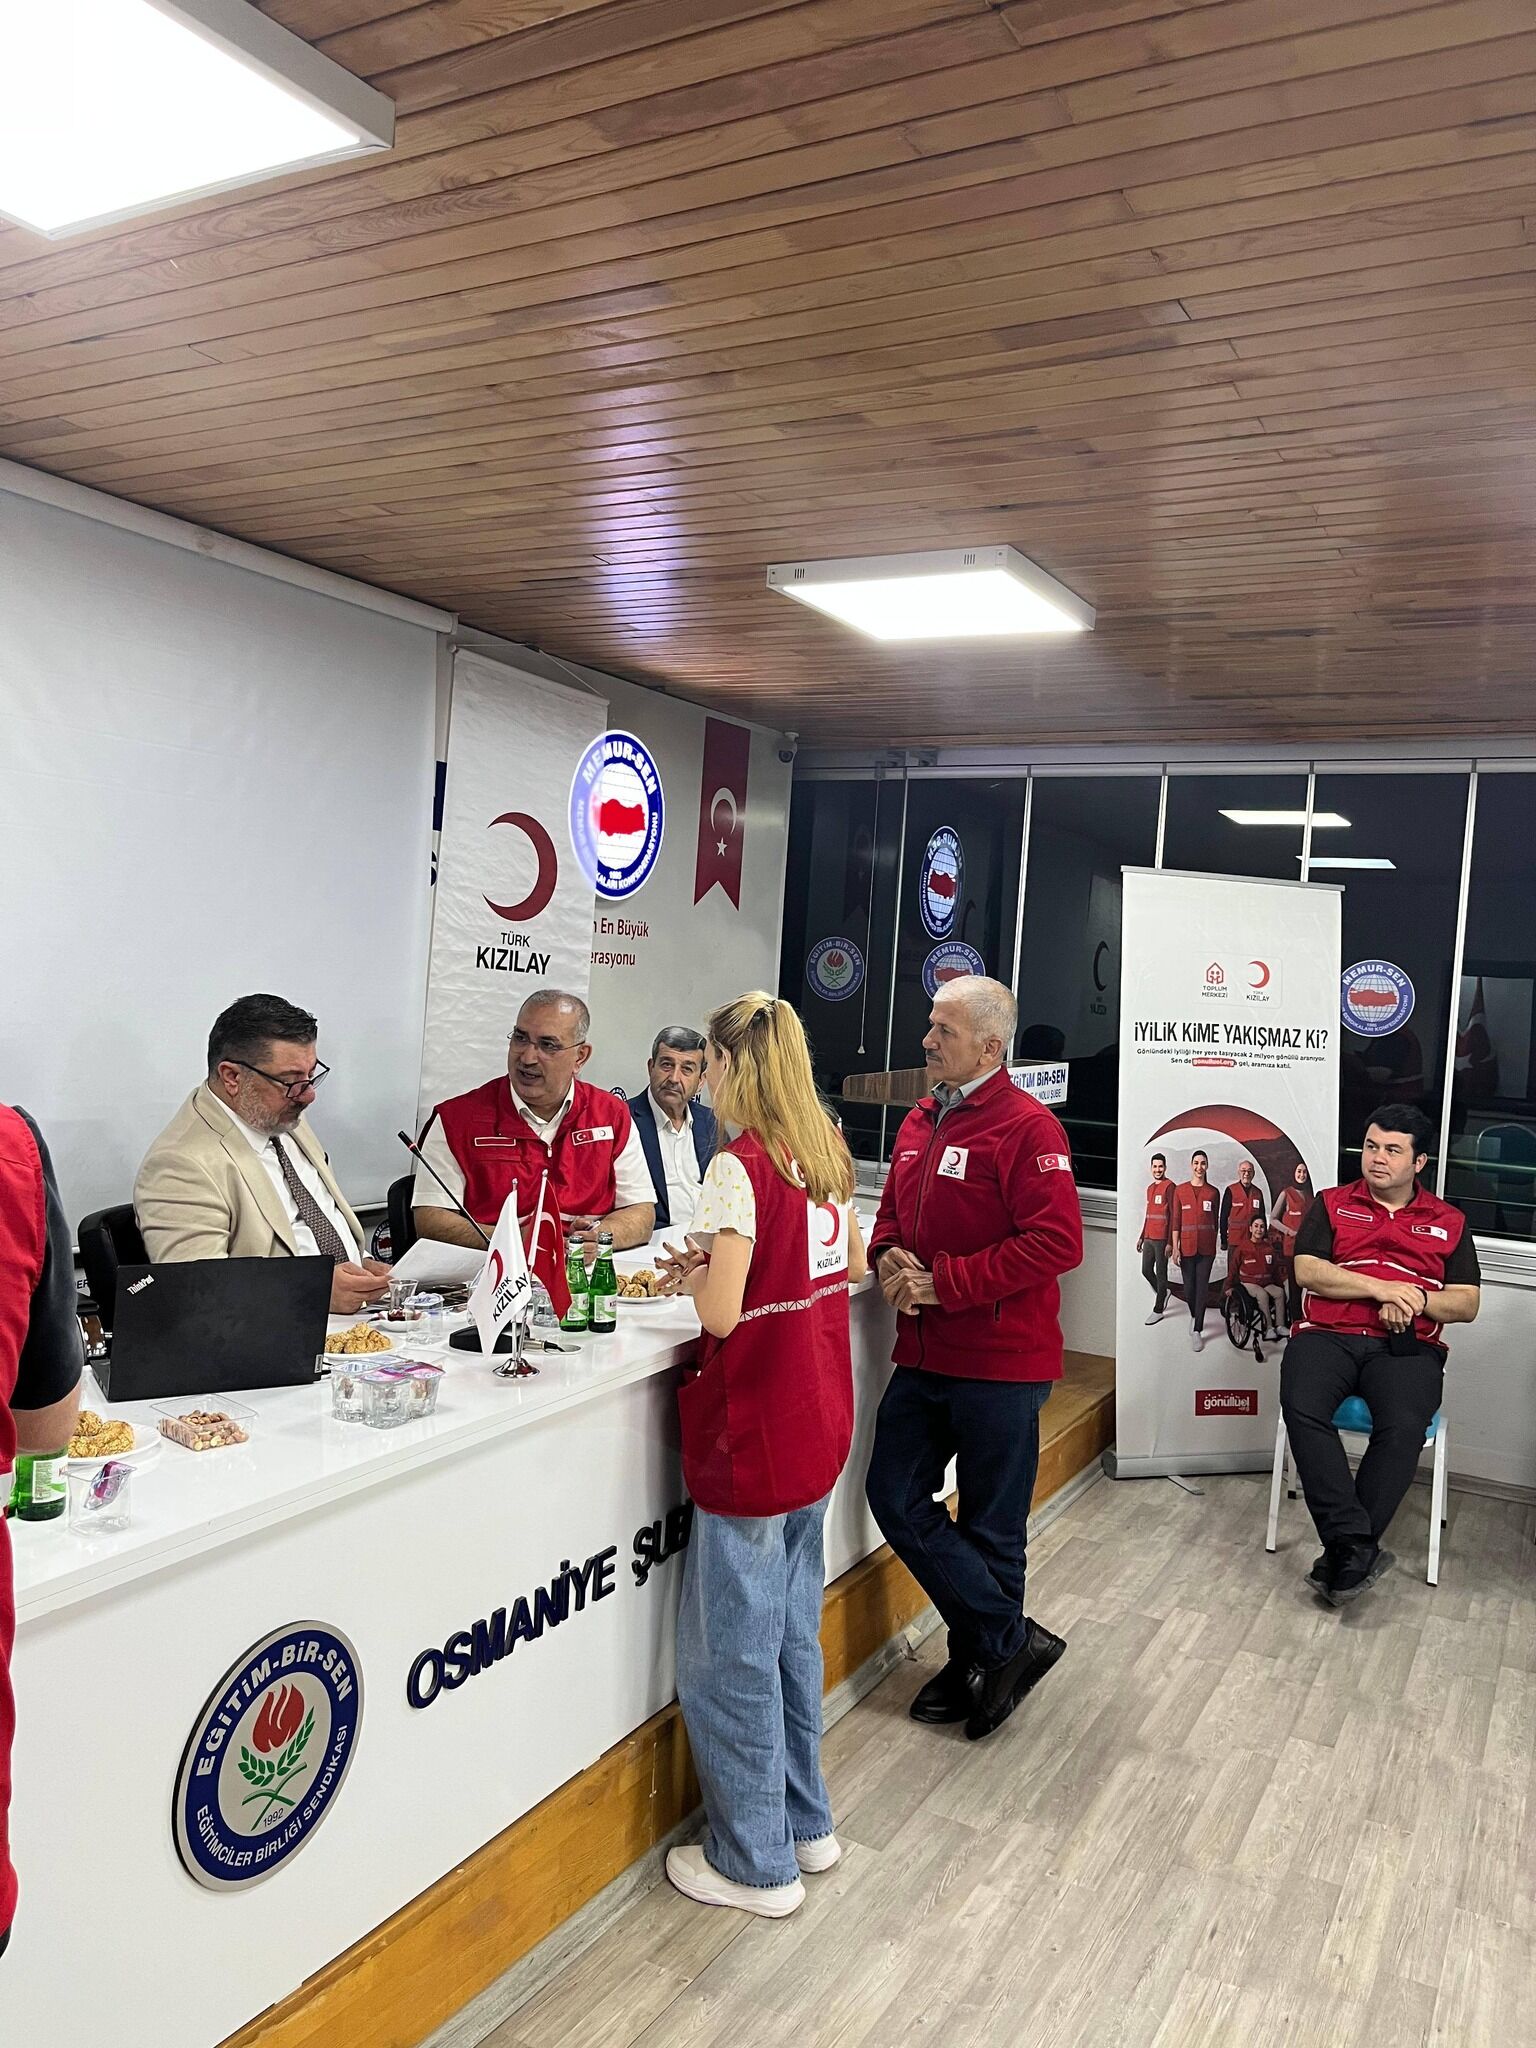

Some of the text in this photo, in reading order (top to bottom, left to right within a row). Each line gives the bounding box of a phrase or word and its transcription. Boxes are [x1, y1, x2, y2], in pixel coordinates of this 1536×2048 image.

[582, 740, 657, 796] MEMUR-SEN
[500, 931, 531, 948] TÜRK
[601, 918, 614, 935] En
[617, 919, 649, 940] Büyük
[476, 945, 552, 975] KIZILAY
[930, 945, 979, 966] MEMUR-SEN
[1342, 964, 1407, 987] MEMUR-SEN
[1223, 1024, 1302, 1050] YAKIŞMAZ
[816, 1255, 841, 1269] KIZILAY
[126, 1274, 155, 1295] ThinkPad
[494, 1275, 512, 1298] TÜRK
[492, 1272, 529, 1322] KIZILAY
[407, 1498, 694, 1709] OSMANİYE ŞUB
[196, 1640, 353, 1777] EĞİTİM-BİR-SEN
[197, 1723, 348, 1867] EĞİTİMCİLER BİRLİĞİ SENDİKASI
[263, 1807, 284, 1828] 1992
